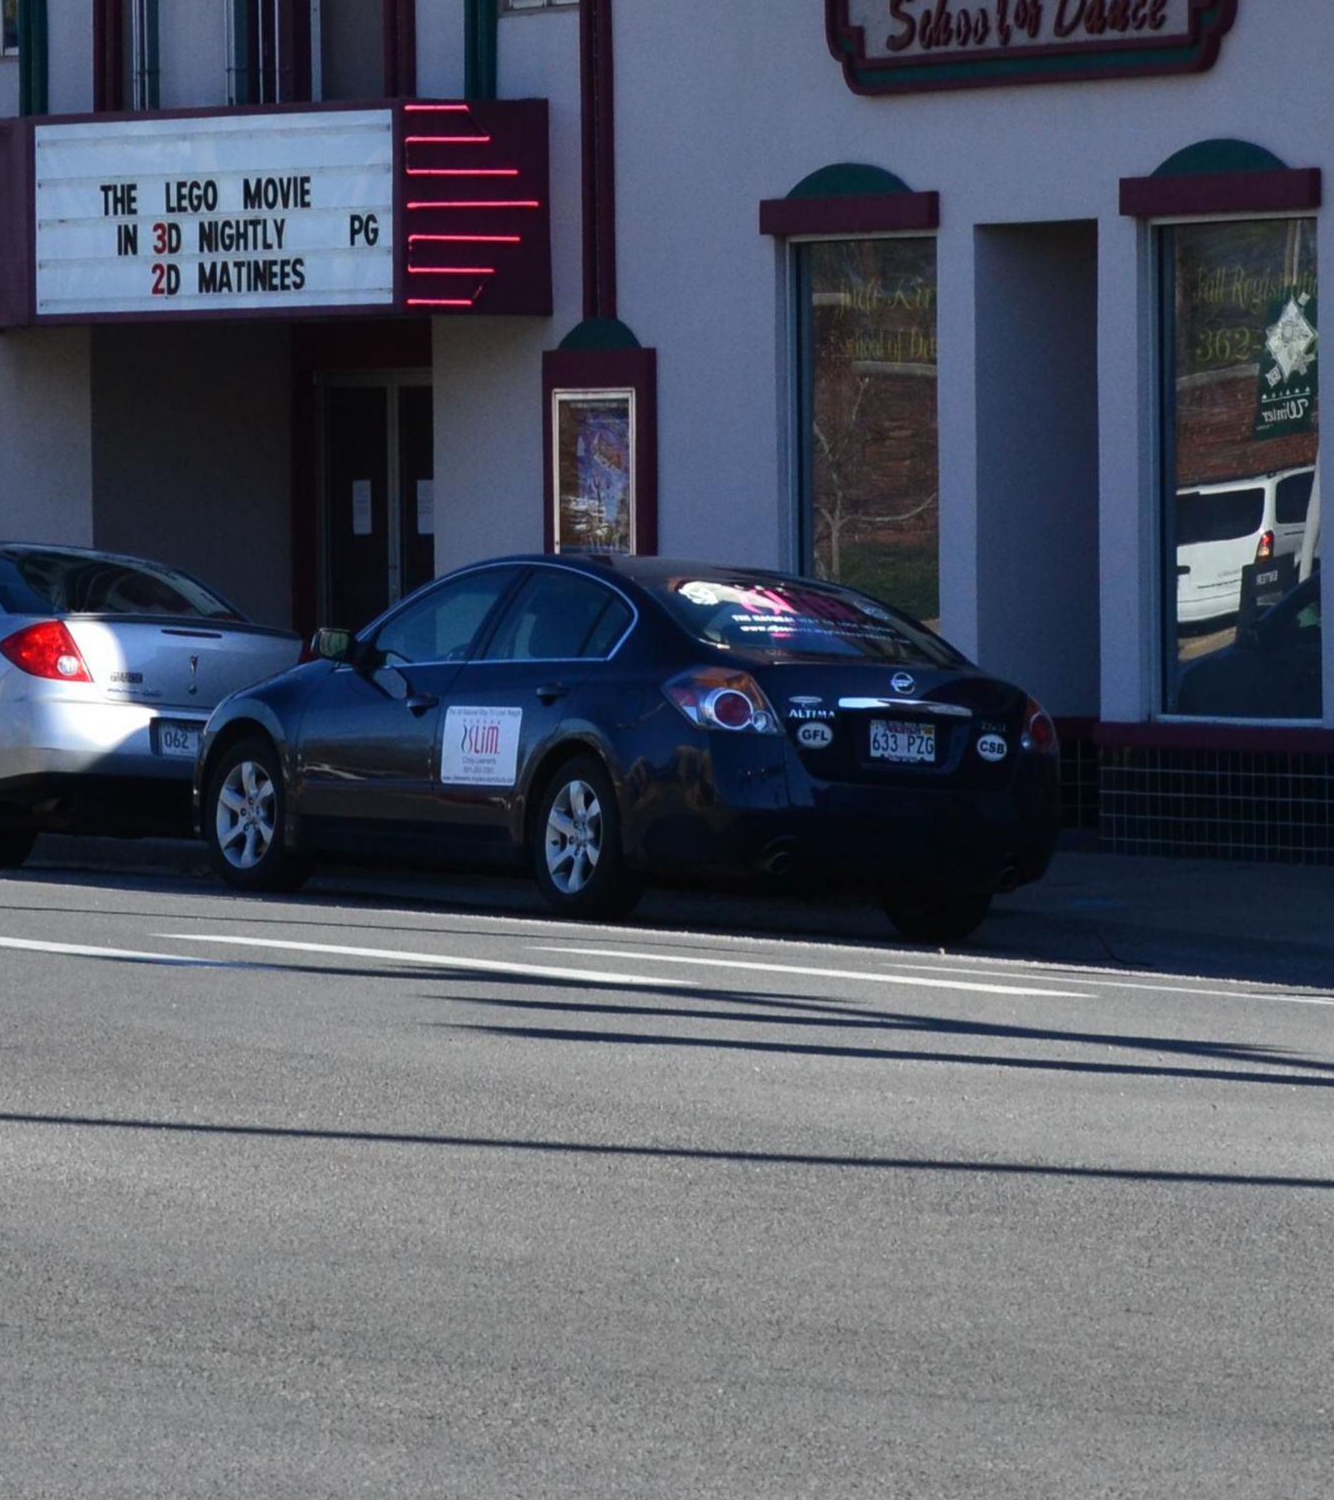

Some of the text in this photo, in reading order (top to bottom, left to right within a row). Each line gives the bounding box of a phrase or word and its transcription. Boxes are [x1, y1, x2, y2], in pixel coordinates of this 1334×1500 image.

[100, 176, 311, 217] THE LEGO MOVIE
[117, 218, 286, 256] IN 3D NIGHTLY
[350, 213, 380, 247] PG
[152, 258, 306, 296] 2D MATINEES
[788, 708, 836, 719] ALTIMA
[164, 731, 190, 750] 062
[801, 728, 830, 742] GFL
[872, 731, 935, 755] 633 PZG
[979, 741, 1006, 754] CSB
